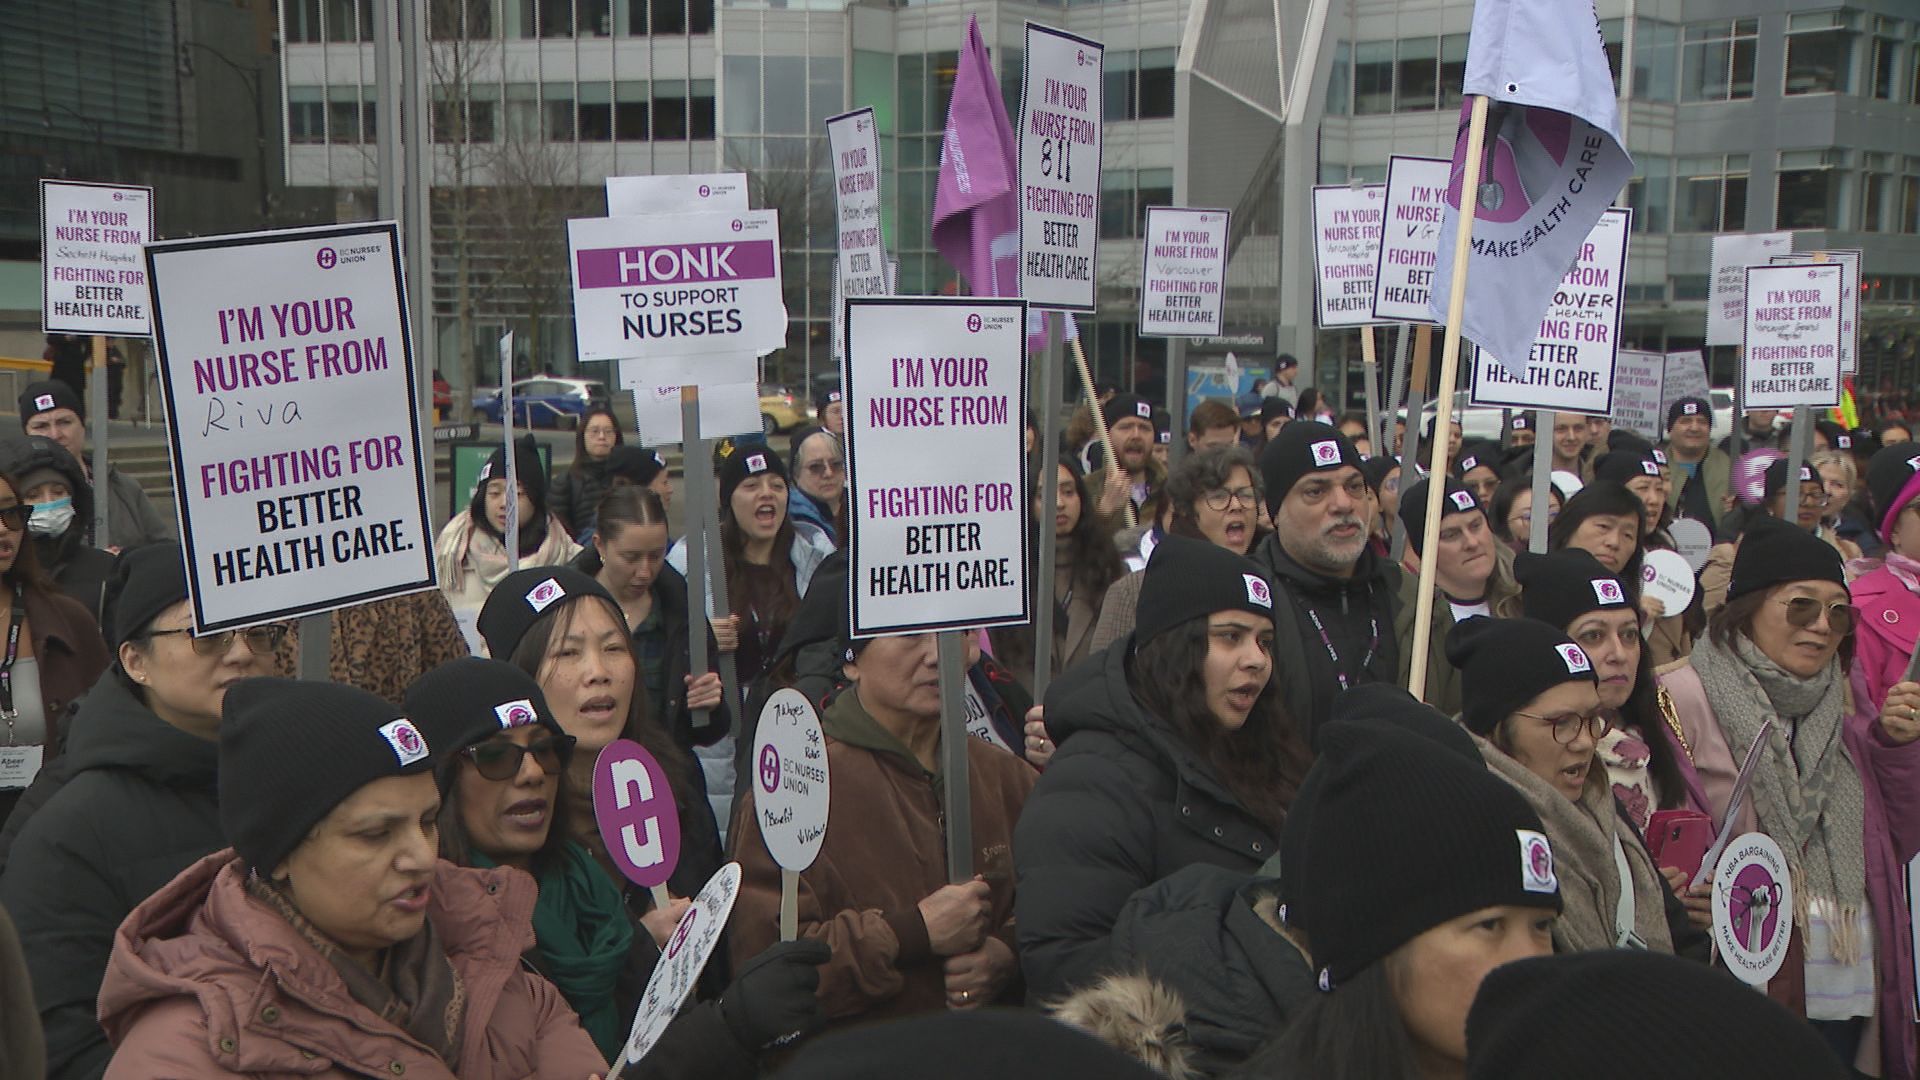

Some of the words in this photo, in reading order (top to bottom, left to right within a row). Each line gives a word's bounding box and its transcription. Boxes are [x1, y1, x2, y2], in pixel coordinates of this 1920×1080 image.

[1044, 78, 1060, 105] I'M
[1062, 83, 1088, 111] YOUR
[1031, 110, 1068, 141] NURSE
[1070, 117, 1095, 146] FROM
[850, 147, 867, 169] YOUR
[839, 176, 856, 196] NURSE
[857, 171, 874, 193] FROM
[1026, 186, 1073, 217] FIGHTING
[1075, 191, 1093, 219] FOR
[1411, 186, 1430, 201] I'M
[1470, 236, 1519, 259] MAKE
[1520, 198, 1572, 254] HEALTH
[1568, 134, 1603, 195] CARE
[68, 209, 88, 223] I'M
[90, 211, 128, 226] YOUR
[1334, 209, 1350, 223] I'M
[1351, 209, 1380, 223] YOUR
[1396, 206, 1440, 222] NURSE
[56, 227, 101, 242] NURSE
[103, 229, 141, 244] FROM
[841, 230, 865, 250] FIGHTING
[1043, 220, 1079, 249] BETTER
[1165, 231, 1180, 243] I'M
[1183, 231, 1210, 244] YOUR
[1324, 226, 1360, 240] NURSE
[1363, 225, 1380, 238] FRO
[340, 254, 366, 264] UNION
[1154, 246, 1188, 259] NURSE
[1190, 246, 1218, 259] FROM
[1388, 248, 1437, 266] FIGHTI
[618, 245, 737, 283] HONK
[850, 253, 871, 273] BETTER
[1026, 251, 1063, 280] HEALTH
[1065, 256, 1090, 282] CARE.
[1324, 264, 1373, 279] FIGHTING
[53, 266, 115, 284] FIGHTING
[118, 271, 144, 285] FOR
[1407, 269, 1434, 285] BET
[75, 285, 123, 301] BETTER
[844, 278, 865, 295] HEALTH
[1150, 279, 1196, 293] FIGHTING
[1199, 281, 1218, 294] FOR
[1343, 280, 1373, 295] BETTE
[621, 292, 648, 309] TO
[653, 287, 739, 307] SUPPORT
[1165, 296, 1201, 308] BETTER
[1326, 297, 1365, 313] HEALTH
[1553, 291, 1615, 309] OUVER
[1767, 290, 1785, 304] I'M
[1789, 289, 1821, 304] YOUR
[54, 302, 103, 318] HEALTH
[106, 304, 145, 320] CARE.
[218, 306, 264, 344] I'M
[270, 296, 356, 337] YOUR
[1148, 309, 1185, 322] HEALTH
[1187, 310, 1216, 323] CARE.
[1555, 309, 1603, 320] HEALTH
[1755, 308, 1795, 322] NURSE
[1798, 306, 1832, 320] FROM
[622, 309, 742, 340] NURSES
[1574, 321, 1608, 343] FOR
[1529, 343, 1577, 365] ETTER
[1752, 346, 1807, 360] FIGHTING
[1811, 344, 1834, 358] FOR
[193, 348, 299, 395] NURSE
[305, 337, 388, 380] FROM
[892, 358, 924, 388] I'M
[931, 357, 989, 387] YOUR
[1771, 362, 1814, 376] BETTER
[1554, 368, 1603, 392] CARE.
[1752, 379, 1796, 394] HEALTH
[1799, 378, 1833, 393] CARE.
[202, 397, 302, 437] Riva
[869, 397, 944, 428] NURSE
[950, 395, 1008, 426] FROM
[1616, 408, 1644, 419] BETTER
[1614, 418, 1631, 428] ALTH
[200, 445, 342, 499] FIGHTING
[348, 435, 404, 473] FOR
[256, 484, 363, 534] BETTER
[868, 484, 968, 519] FIGHTING
[974, 482, 1013, 512] FOR
[906, 522, 981, 556] BETTER
[212, 536, 325, 586] HEALTH
[332, 519, 414, 564] CARE.
[869, 563, 950, 597] HEALTH
[956, 558, 1015, 591] CARE.
[783, 777, 809, 797] UNION
[1725, 857, 1739, 879] NBA
[1739, 846, 1781, 874] BARGAINING
[1722, 925, 1735, 951] MAKE
[1735, 951, 1757, 971] HEALTH
[1757, 955, 1774, 971] CARE
[1773, 920, 1786, 956] BETTER
